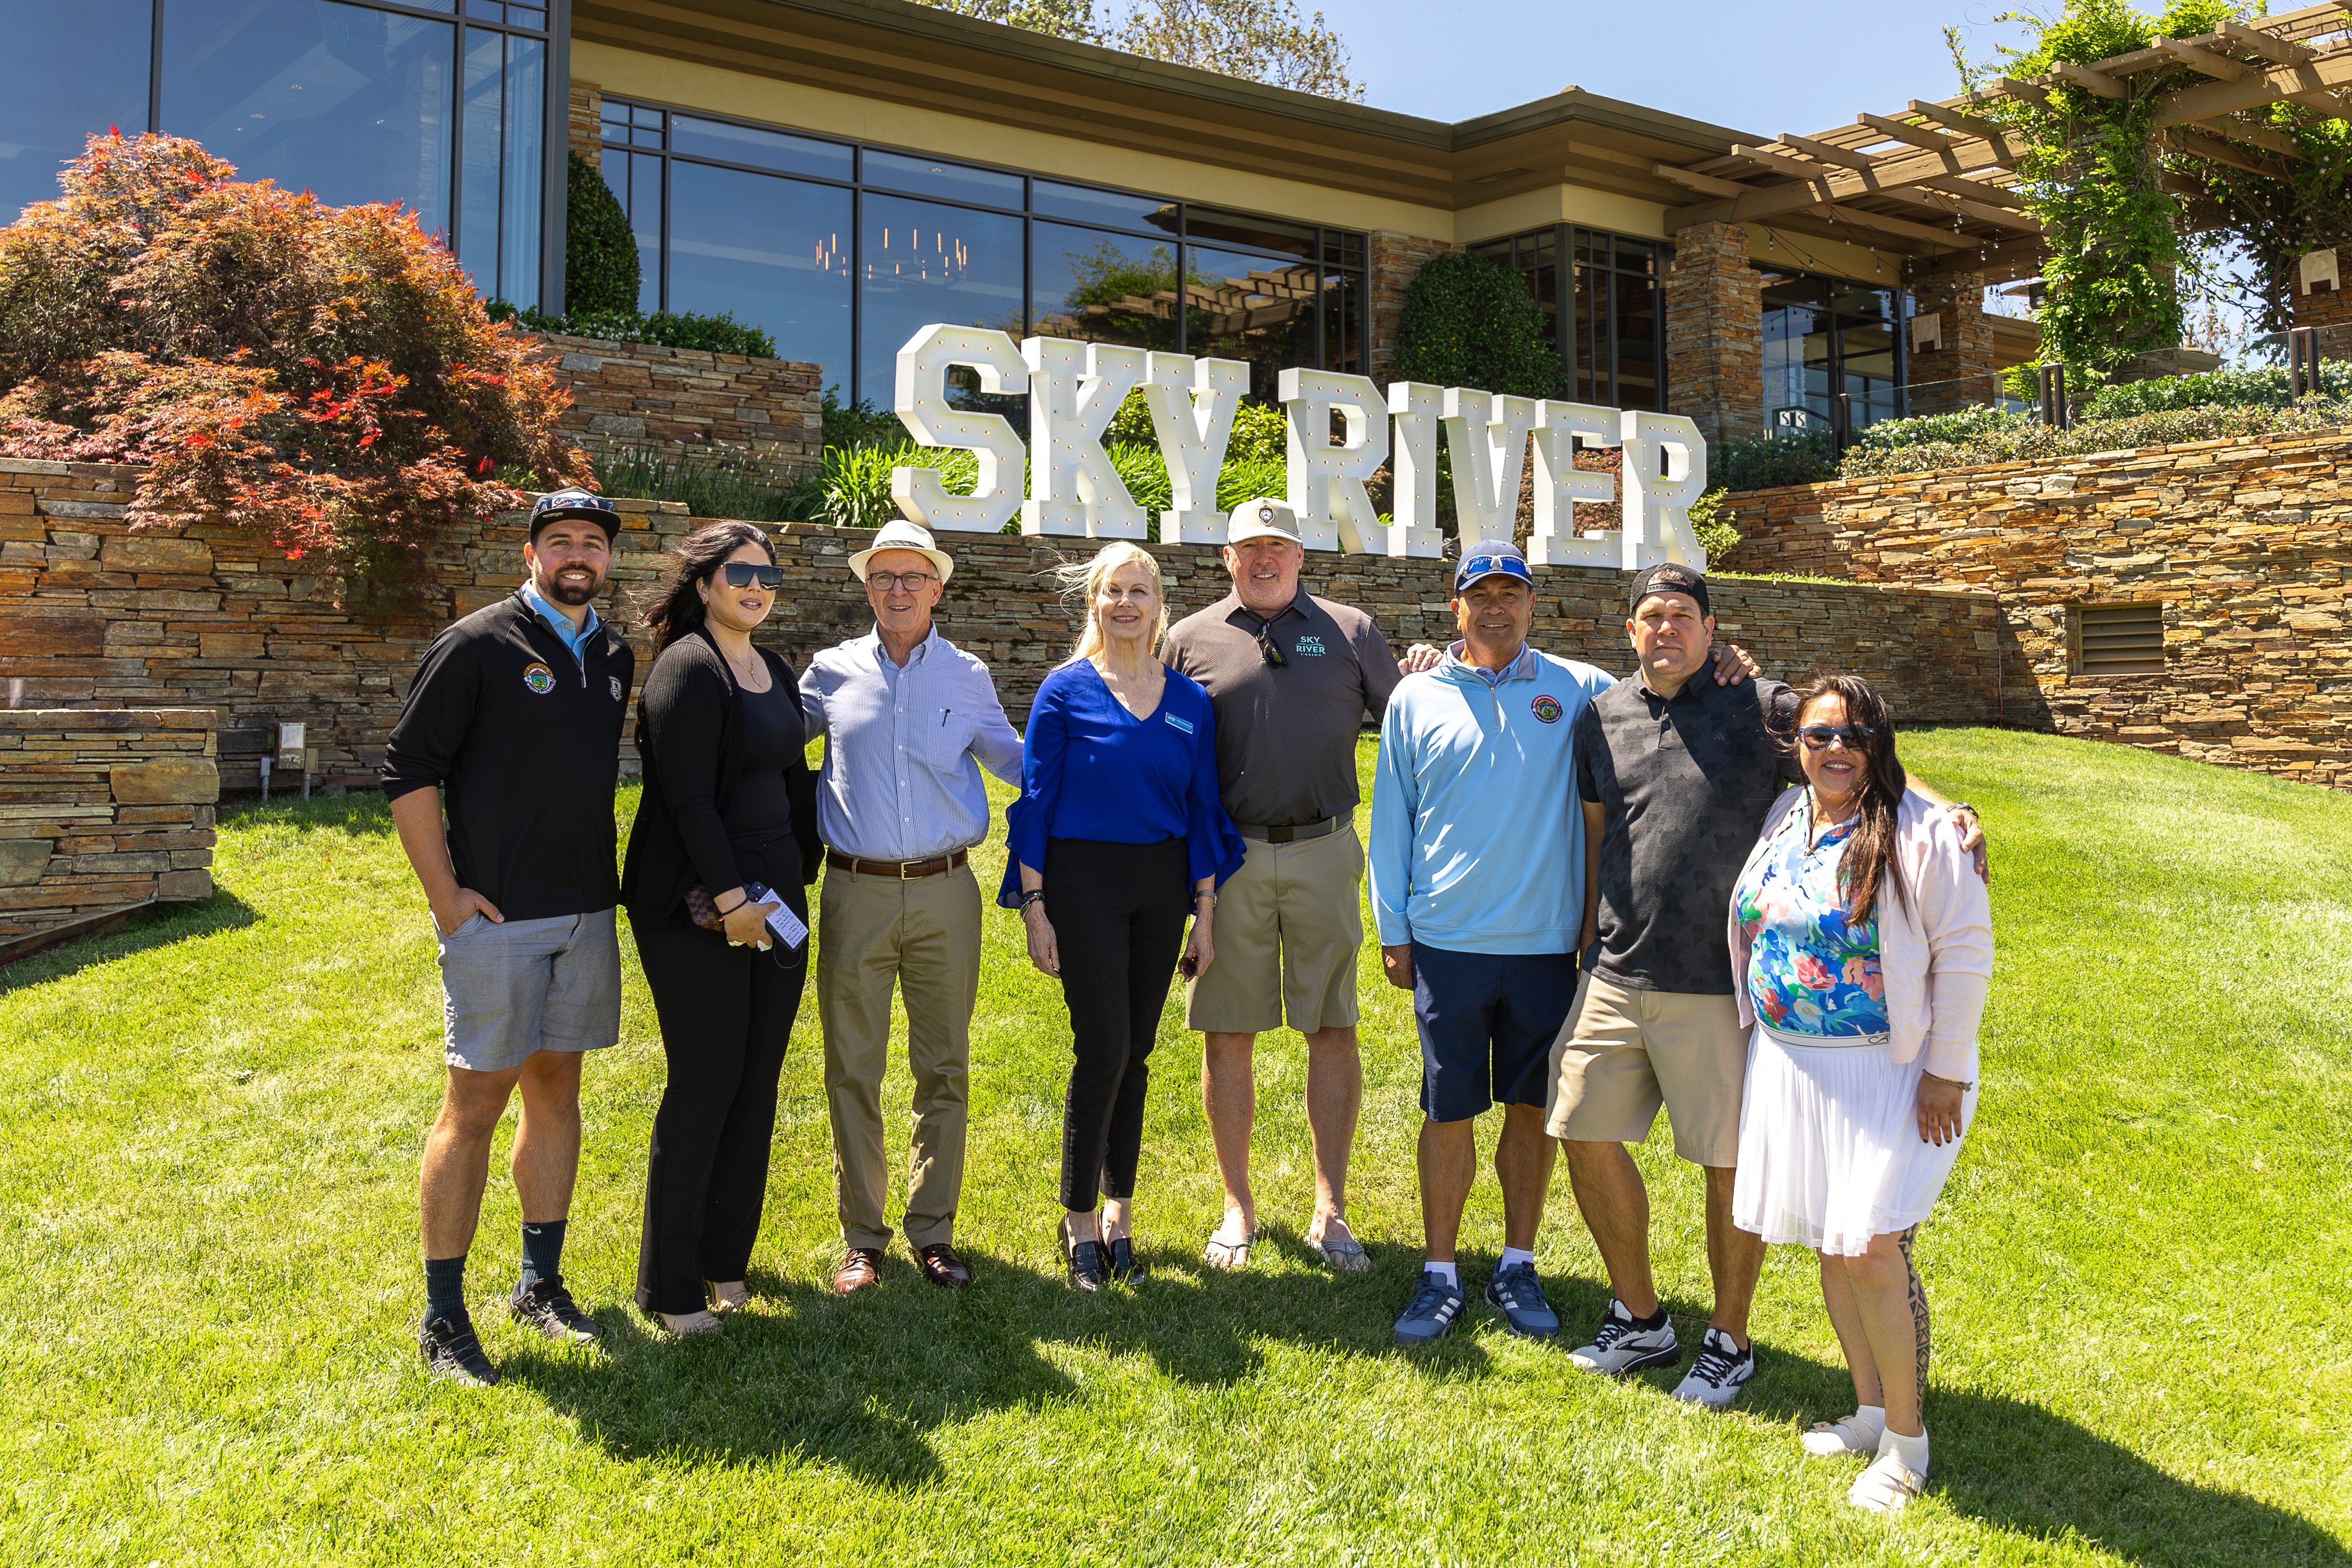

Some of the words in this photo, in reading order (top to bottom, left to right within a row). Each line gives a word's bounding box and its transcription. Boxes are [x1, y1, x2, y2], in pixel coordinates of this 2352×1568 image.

[891, 323, 1250, 545] SKY
[1279, 367, 1706, 573] RIVER
[1296, 645, 1326, 654] RIVER
